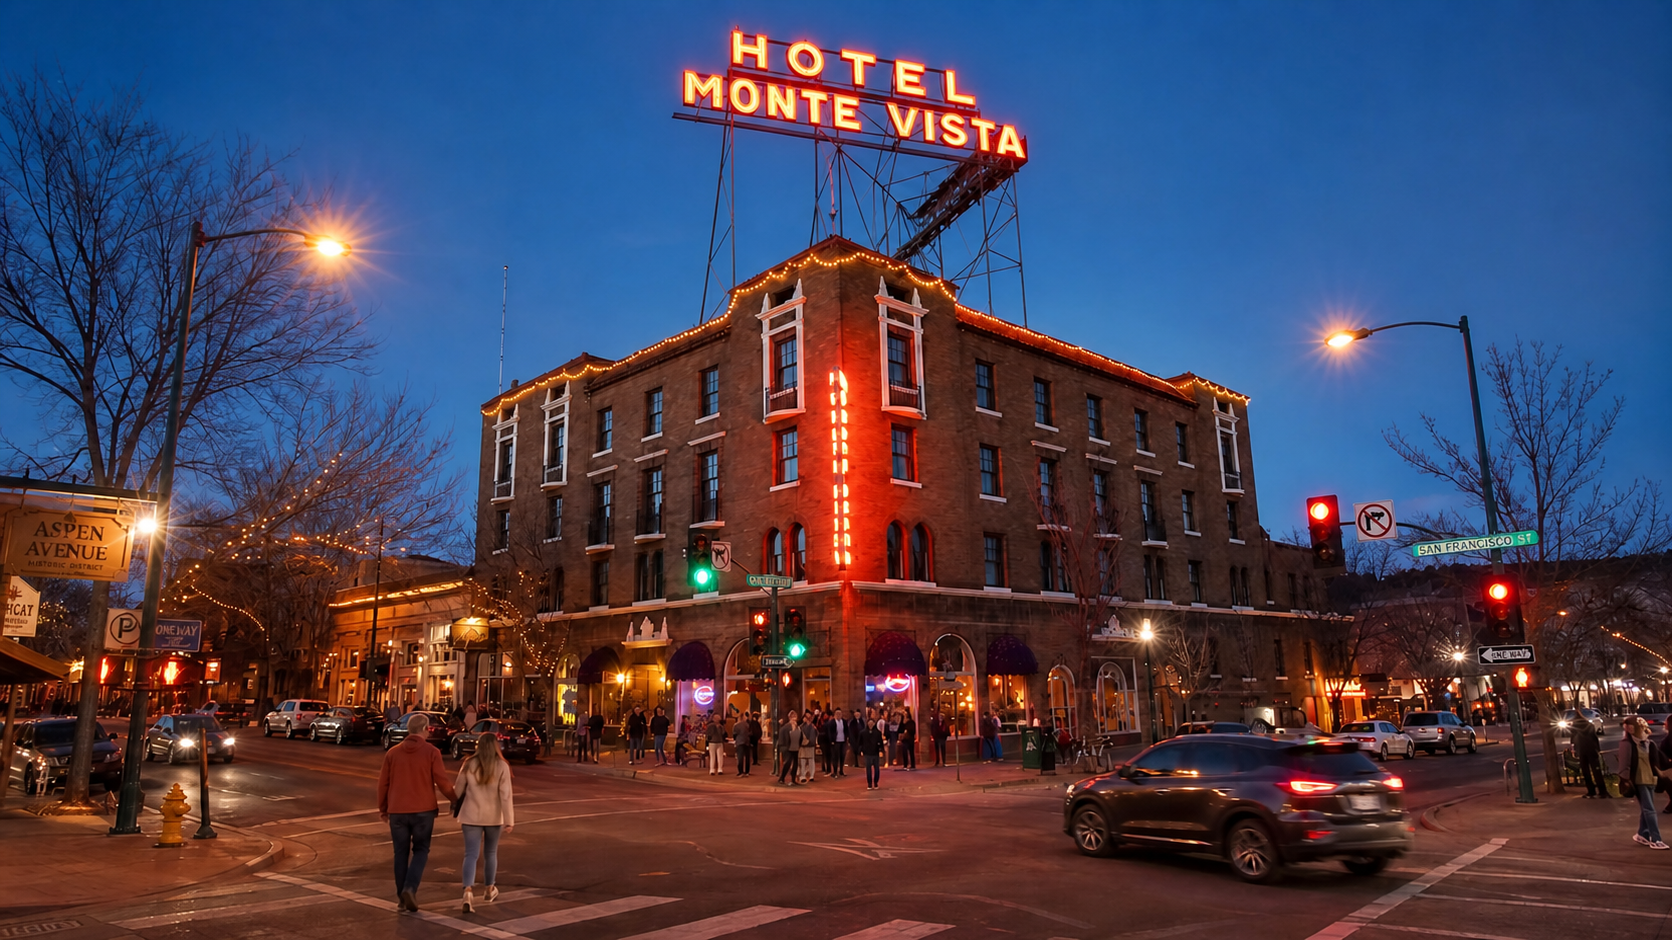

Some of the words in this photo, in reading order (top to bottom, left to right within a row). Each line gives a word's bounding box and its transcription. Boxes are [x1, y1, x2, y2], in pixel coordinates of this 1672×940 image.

[731, 29, 976, 108] HOTEL
[683, 69, 862, 132] MONTE
[886, 101, 1026, 159] VISTA
[33, 521, 105, 541] ASPEN
[24, 541, 108, 561] AVENUE
[1419, 545, 1441, 555] SAN
[1446, 536, 1512, 552] FRANCISCO
[1517, 533, 1532, 545] ST
[69, 563, 104, 571] DISTRICT
